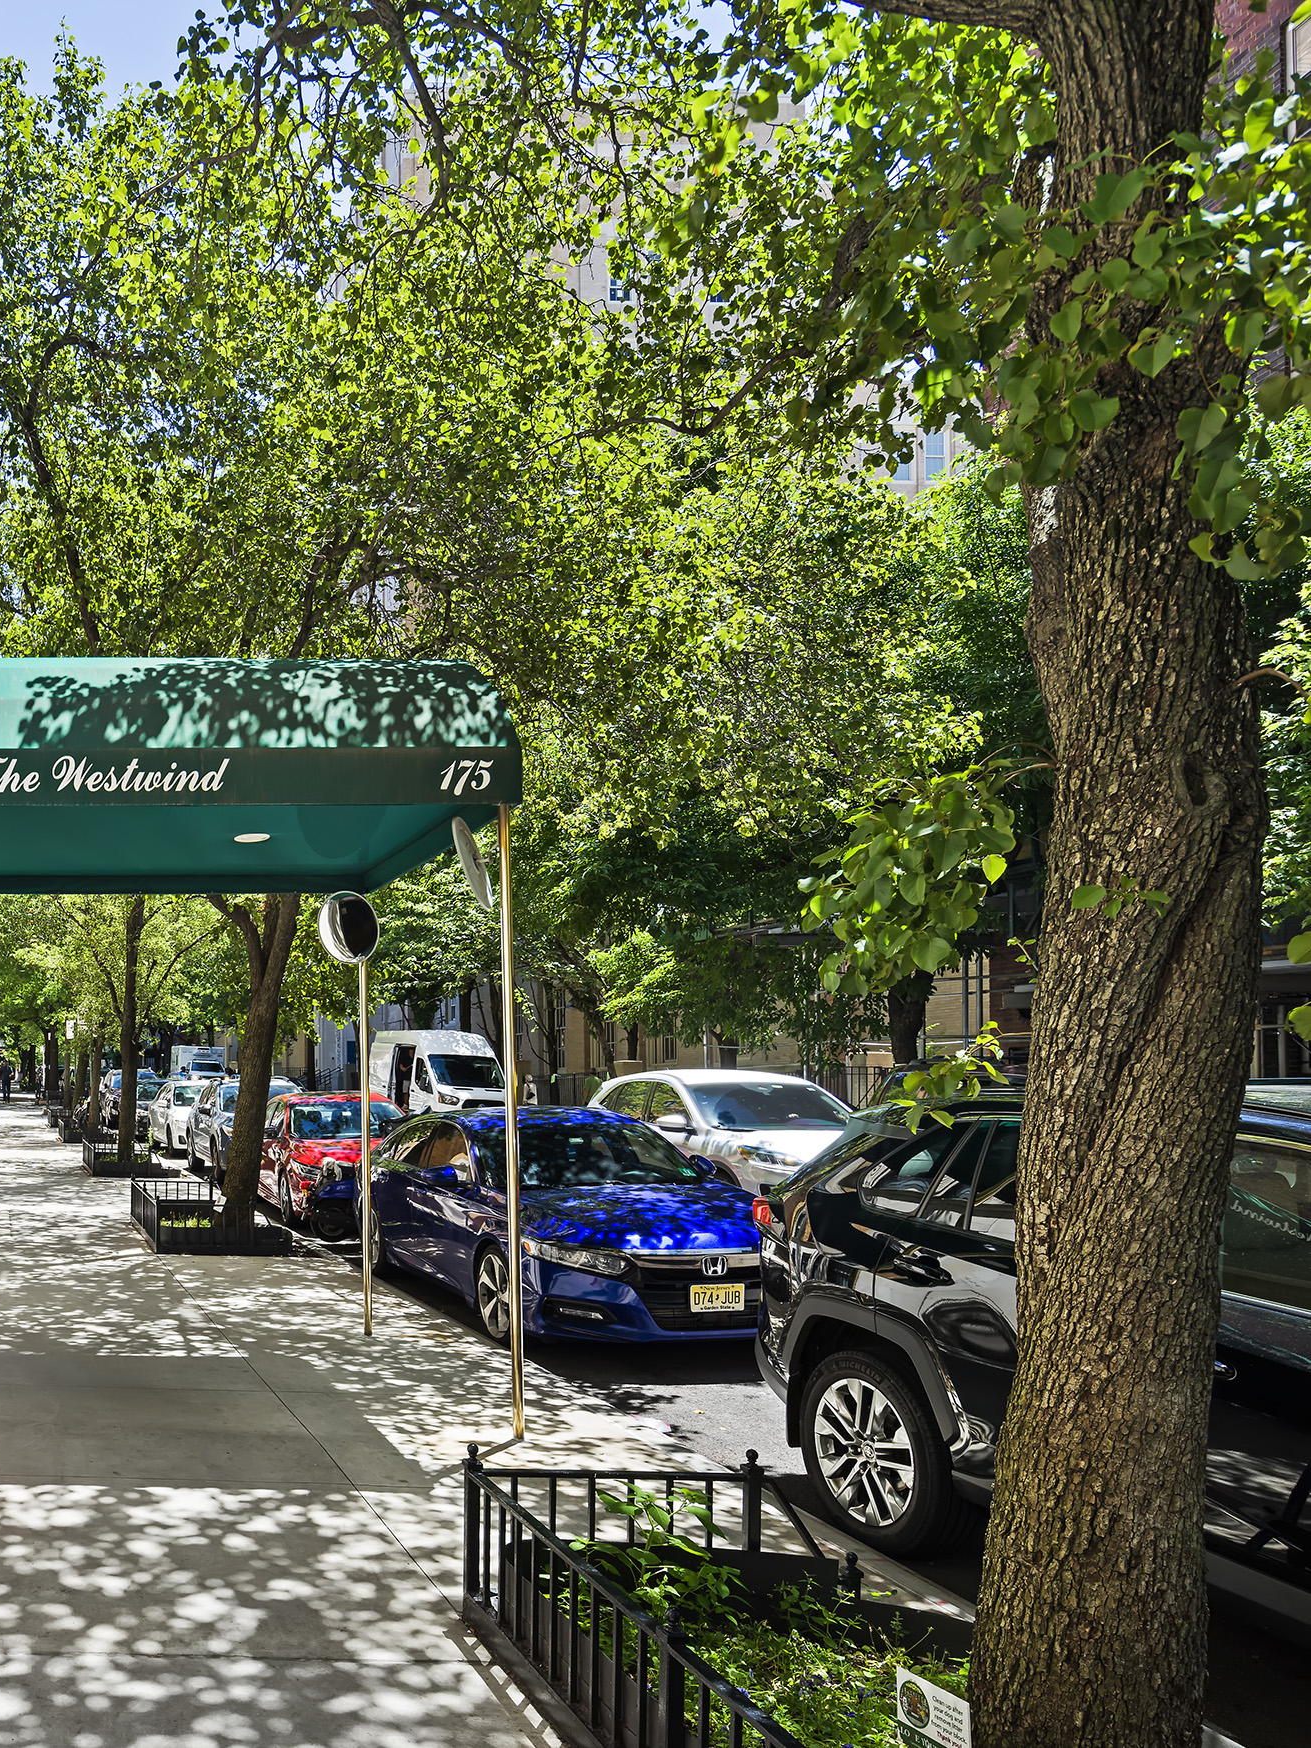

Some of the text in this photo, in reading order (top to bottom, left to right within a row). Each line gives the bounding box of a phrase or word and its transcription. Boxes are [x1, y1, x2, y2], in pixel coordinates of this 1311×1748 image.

[51, 754, 230, 794] Westwind
[439, 758, 494, 797] 175
[694, 1290, 741, 1305] D74 JUB
[838, 1361, 882, 1383] MICHELIN
